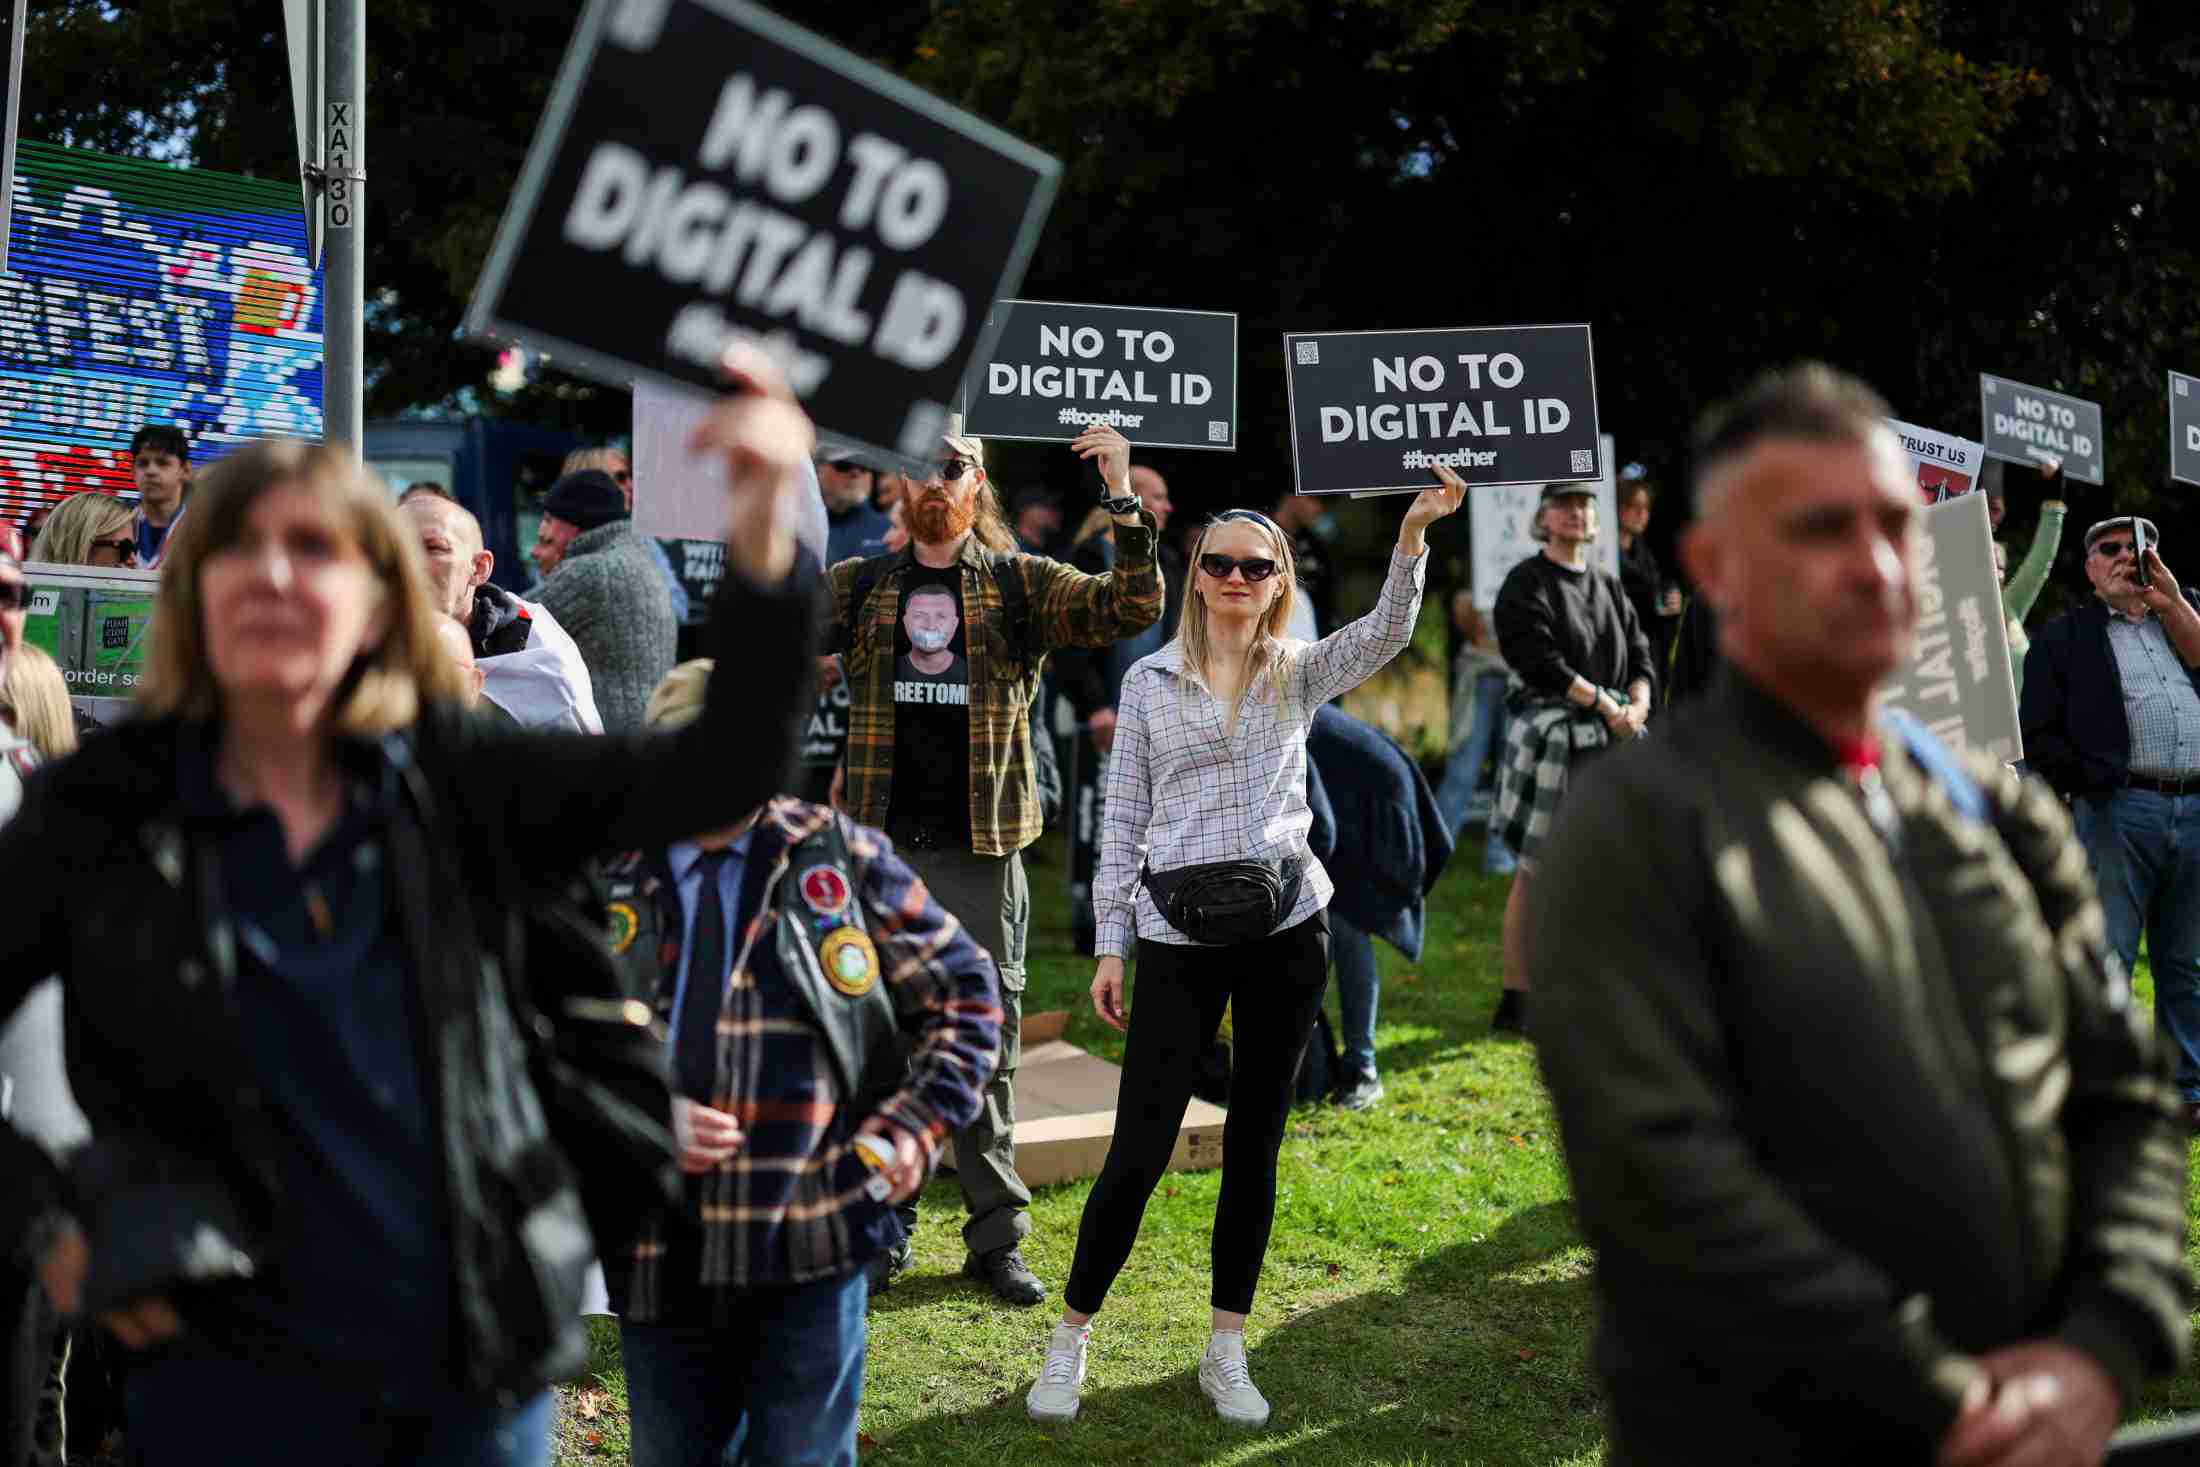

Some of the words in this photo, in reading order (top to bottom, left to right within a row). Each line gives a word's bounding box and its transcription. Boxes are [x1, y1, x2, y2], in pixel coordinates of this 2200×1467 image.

[699, 72, 841, 202] NO
[839, 131, 950, 251] TO
[563, 141, 872, 344] DIGITAL
[873, 268, 967, 370] ID
[1040, 325, 1104, 358] NO
[1116, 329, 1174, 362] TO
[988, 363, 1158, 403] DIGITAL
[1170, 373, 1212, 405] ID
[1372, 356, 1445, 392] NO
[1458, 353, 1524, 389] TO
[1058, 408, 1143, 428] #together
[1320, 400, 1510, 443] DIGITAL
[1523, 398, 1571, 434] ID
[2015, 396, 2045, 420] NO
[2048, 404, 2075, 429] TO
[1898, 432, 1944, 457] TRUST
[1948, 448, 1966, 464] US
[1994, 413, 2070, 451] DIGITAL
[2072, 433, 2092, 457] ID
[1402, 448, 1496, 469] #together
[63, 668, 117, 684] order
